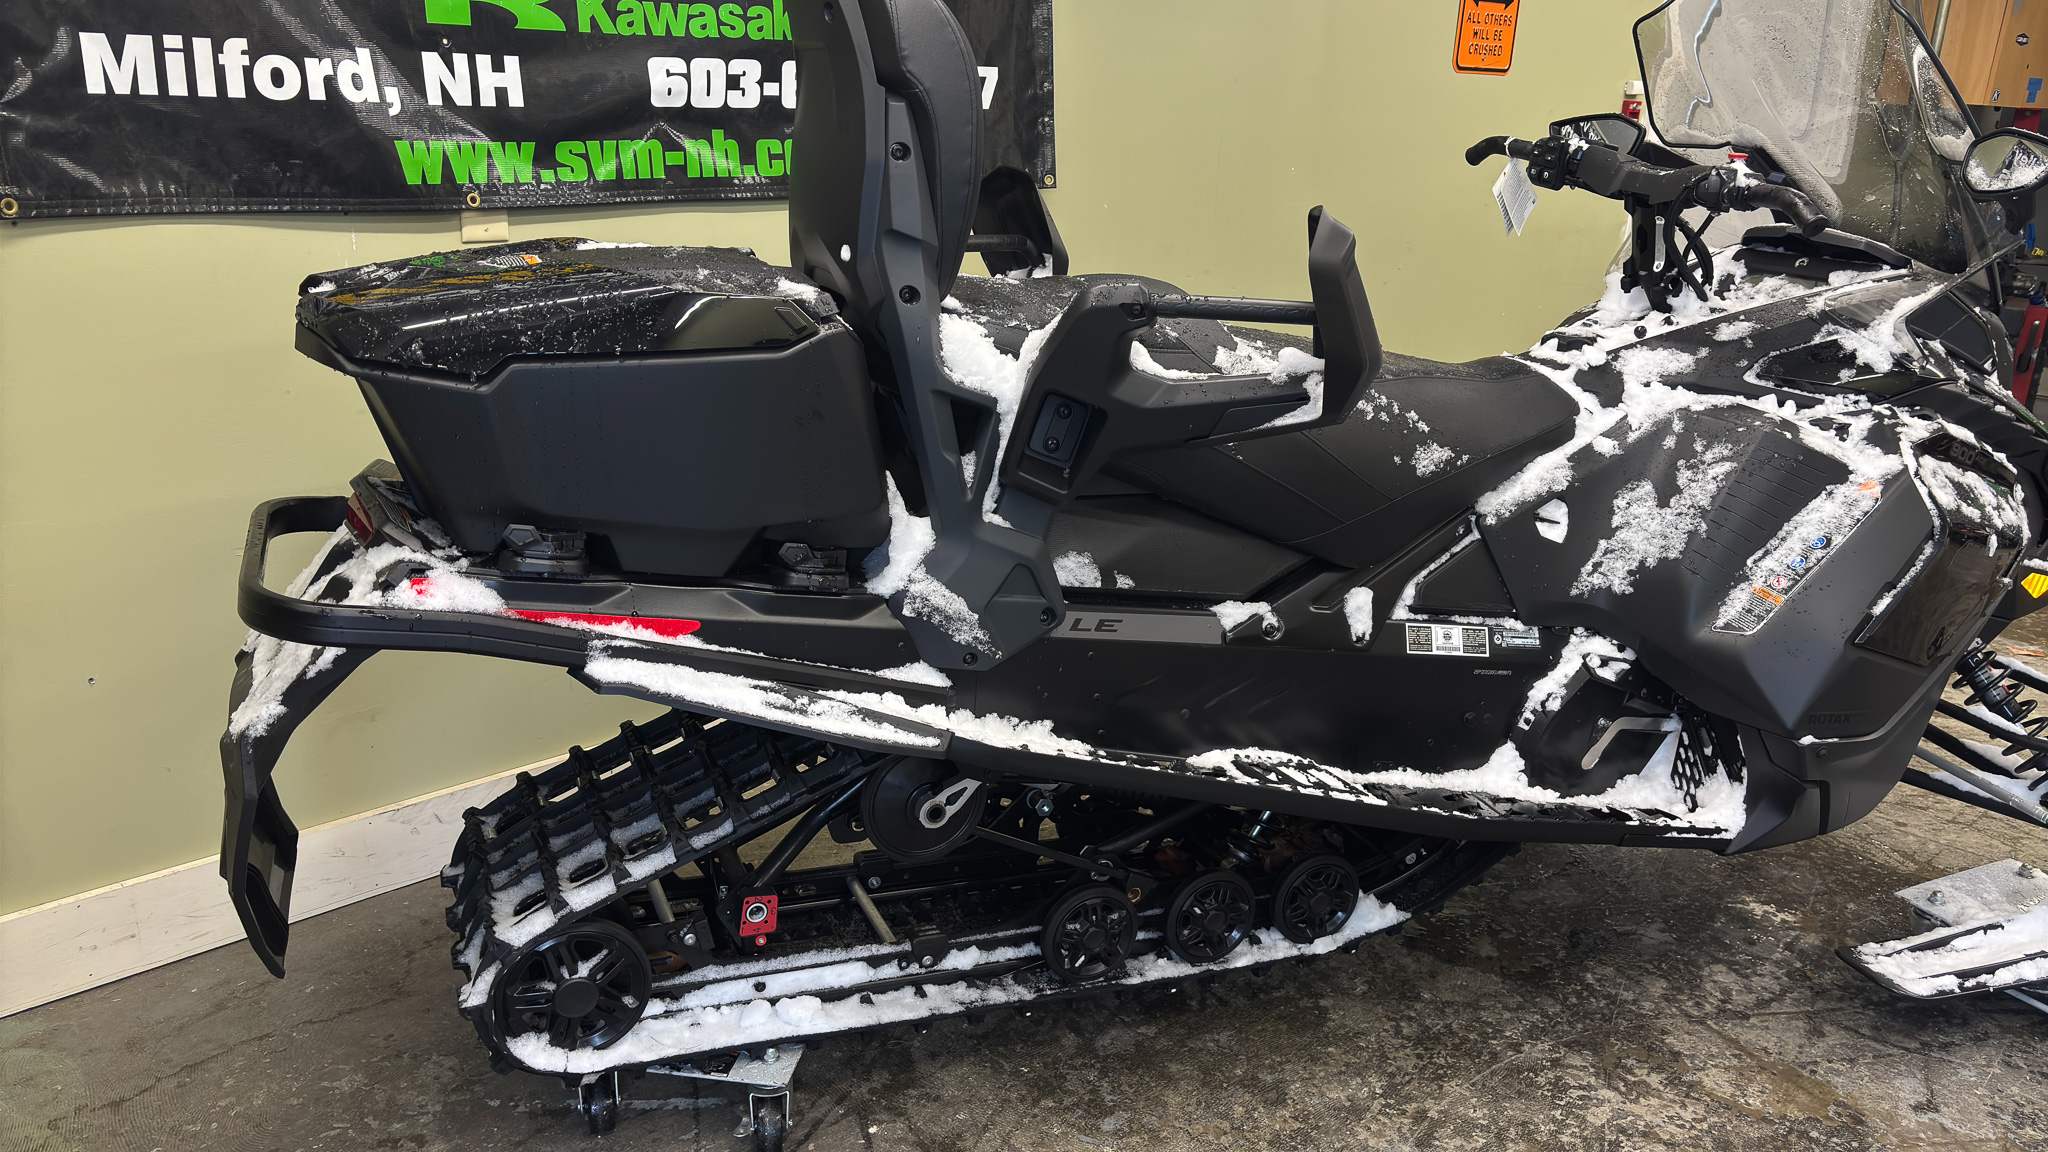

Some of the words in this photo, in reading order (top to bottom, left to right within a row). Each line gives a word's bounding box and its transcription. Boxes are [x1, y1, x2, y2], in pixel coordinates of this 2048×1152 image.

[577, 0, 793, 41] Kawasak
[1466, 11, 1481, 24] ALL
[1485, 13, 1512, 27] OTHERS
[1473, 28, 1490, 41] WILL
[1493, 30, 1503, 41] BE
[1469, 43, 1503, 57] CRUSHED
[79, 31, 401, 116] Milford,
[421, 51, 525, 108] NH
[394, 129, 794, 185] www.svm-nh.c
[1069, 617, 1124, 633] LE
[1808, 713, 1851, 725] ROTAX
